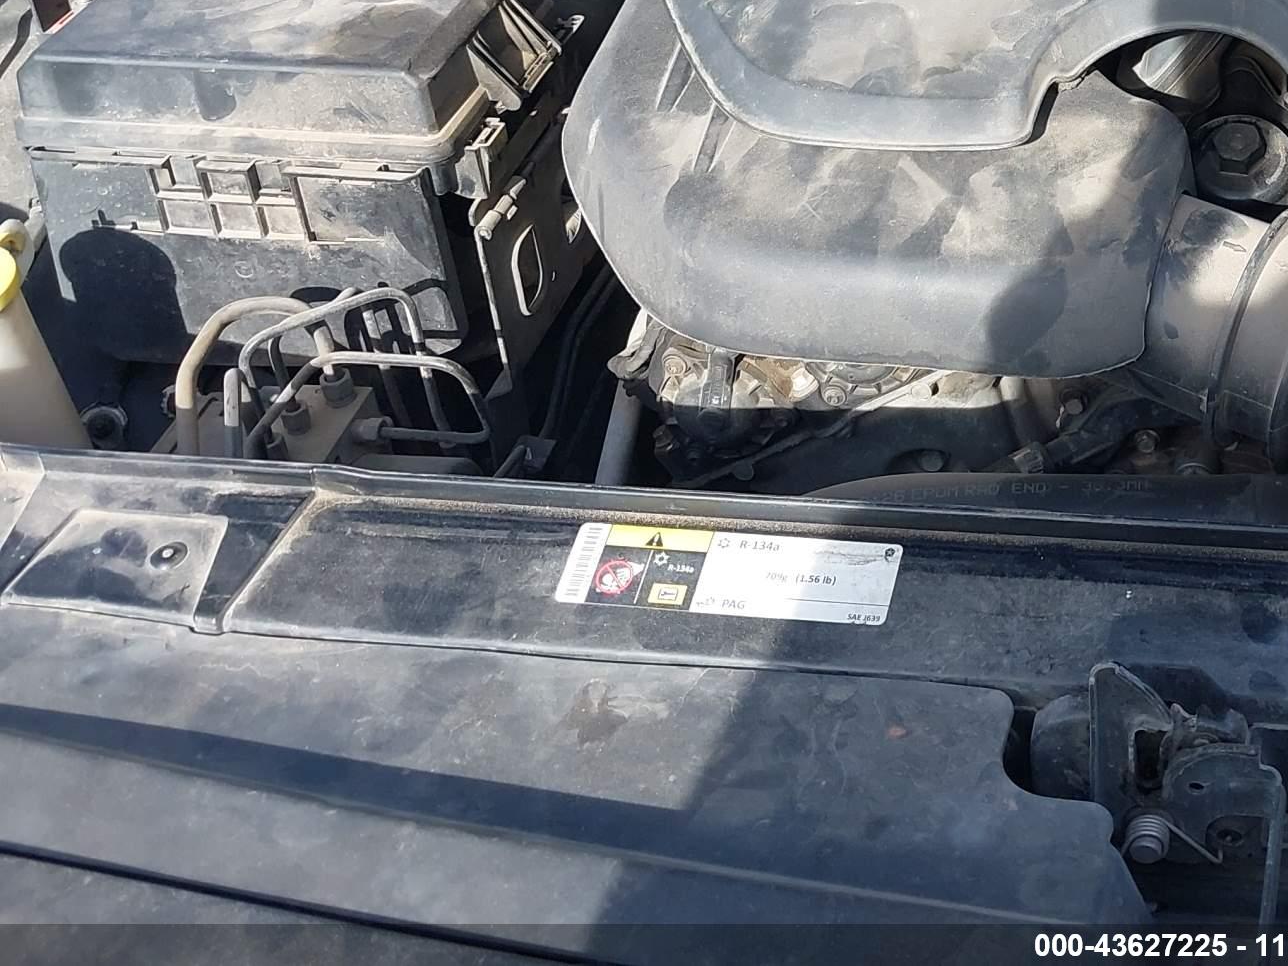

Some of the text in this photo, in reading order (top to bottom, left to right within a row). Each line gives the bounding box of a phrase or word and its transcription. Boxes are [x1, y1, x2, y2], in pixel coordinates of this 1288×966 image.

[739, 541, 781, 553] R-134a
[795, 573, 822, 585] (1.56
[822, 574, 837, 586] lb)
[721, 598, 746, 610] PAG
[847, 613, 862, 622] SAE
